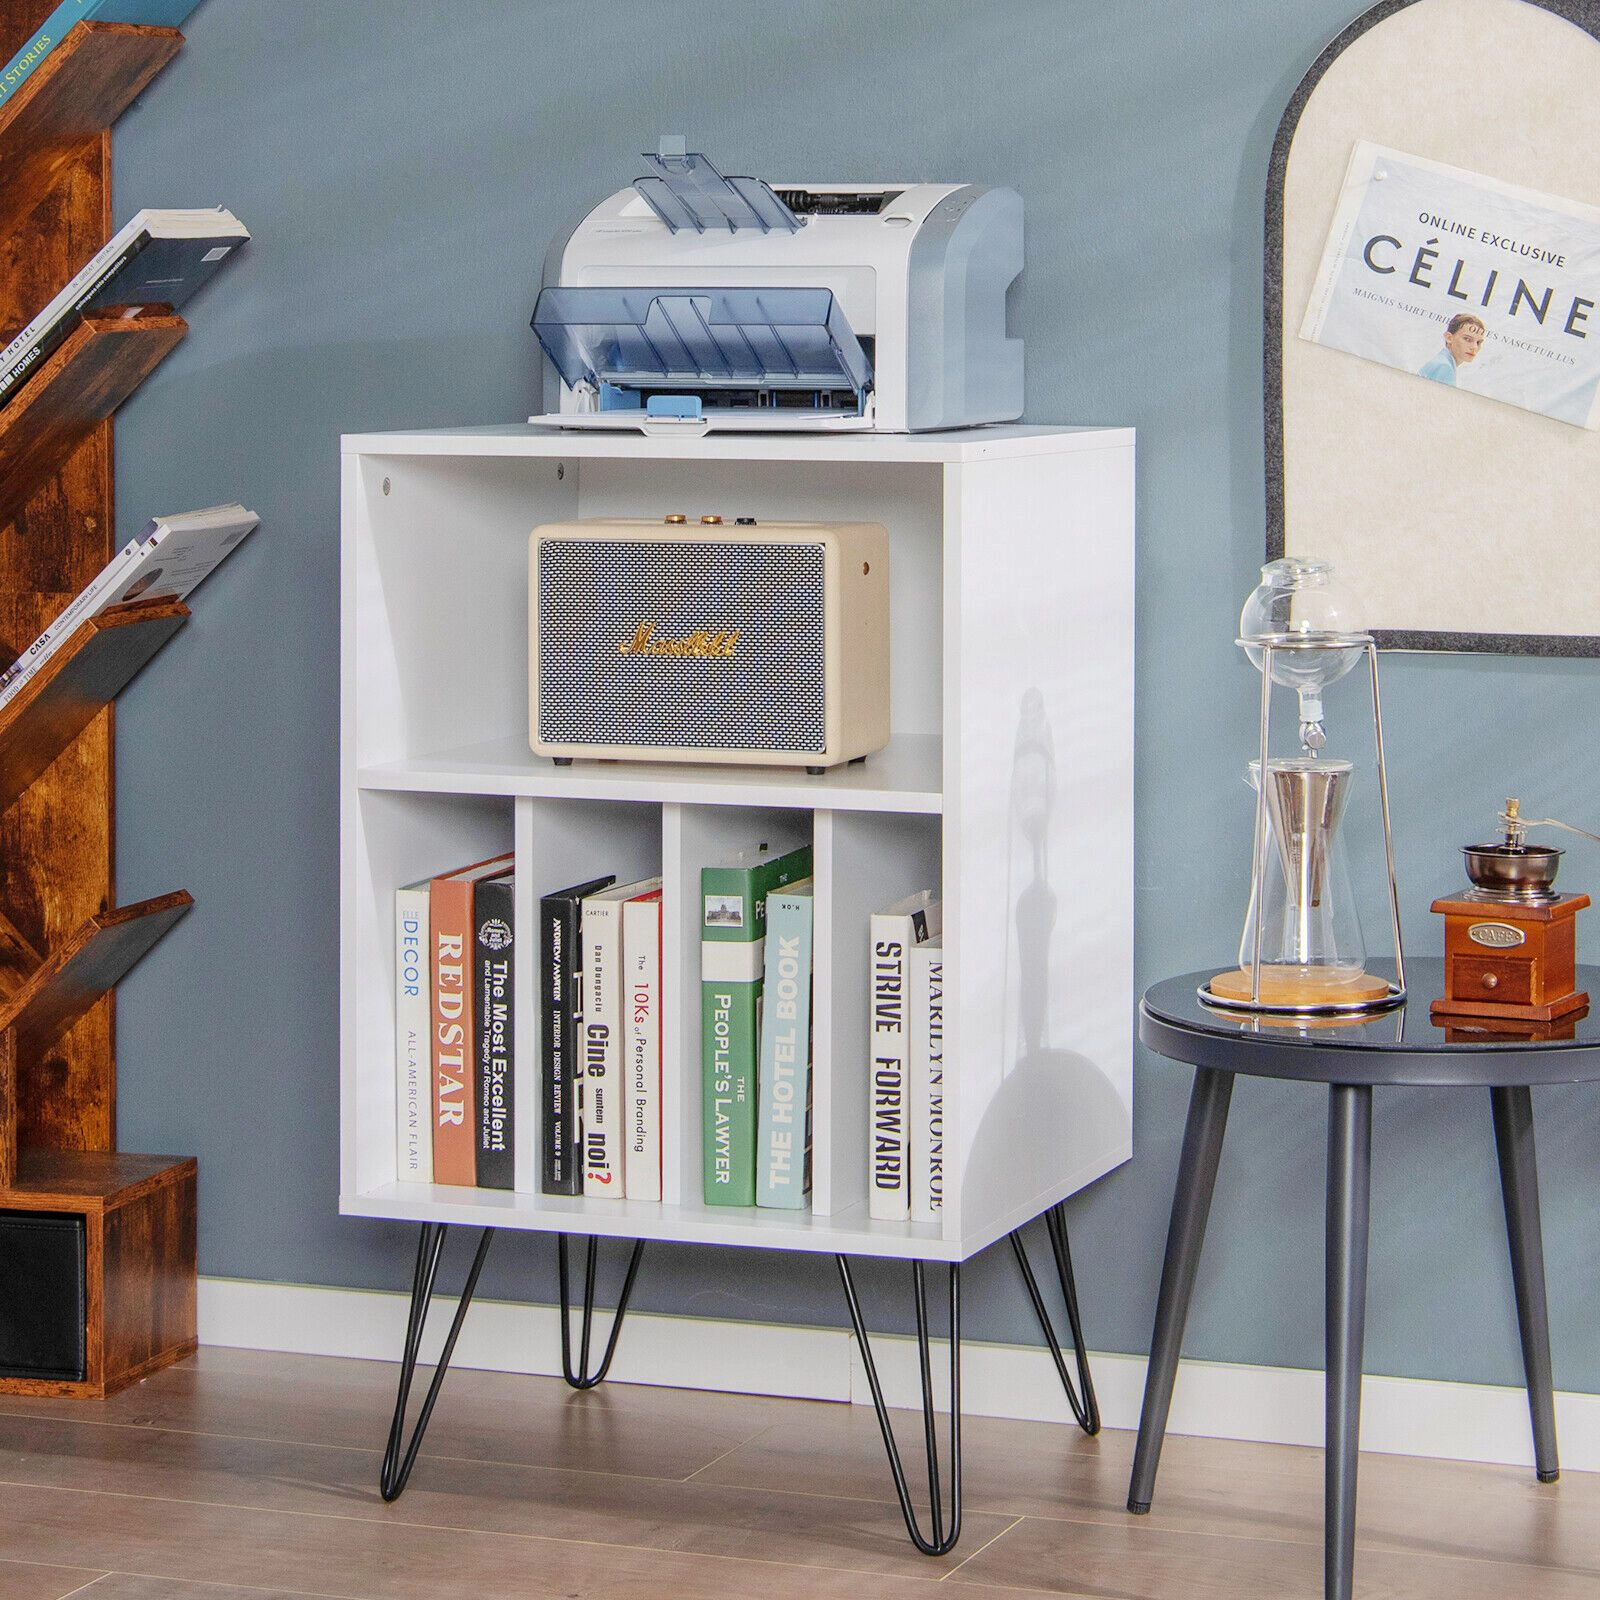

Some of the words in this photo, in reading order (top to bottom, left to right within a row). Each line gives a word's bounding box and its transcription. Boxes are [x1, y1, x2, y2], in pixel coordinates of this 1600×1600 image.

[5, 34, 51, 85] STORIES
[1418, 211, 1477, 240] ONLINE
[1481, 231, 1567, 269] EXCLUSIVE
[1363, 234, 1596, 340] CÉLINE
[8, 326, 36, 355] HOTEL
[13, 346, 42, 378] HOMES
[29, 633, 51, 656] CASA
[54, 594, 89, 631] CONTEMPORARY
[87, 584, 98, 596] LIFE
[403, 920, 419, 997] DECOR
[553, 918, 561, 963] ANDREW
[594, 945, 602, 963] Dan
[638, 955, 646, 970] The
[483, 978, 492, 1028] Lamentable
[492, 961, 508, 999] The
[553, 963, 561, 1001] MARTIN
[594, 966, 602, 1012] Dungaciu
[634, 983, 649, 1023] 10Ks
[776, 936, 800, 1021] BOOK
[875, 942, 902, 1033] STRIVE
[438, 931, 465, 1127] REDSTAR
[482, 1030, 491, 1065] Tragedy
[492, 1003, 508, 1054] Most
[553, 1010, 561, 1049] INTERIOR
[634, 1027, 642, 1036] of
[714, 994, 732, 1093] PEOPLE'S
[928, 961, 943, 1086] MARILYN
[483, 1065, 491, 1075] of
[553, 1051, 561, 1081] DESIGN
[586, 1024, 610, 1078] Cine
[635, 1037, 647, 1093] Personal
[772, 1027, 796, 1124] HOTEL
[408, 1031, 418, 1128] ALL-AMERICAN
[483, 1076, 491, 1107] Romeo
[491, 1058, 508, 1151] Excellent
[553, 1084, 561, 1114] REVIEW
[737, 1076, 746, 1102] THE
[483, 1108, 491, 1126] and
[595, 1088, 603, 1124] suntem
[634, 1098, 647, 1153] Branding
[875, 1057, 901, 1190] FORWARD
[408, 1134, 418, 1170] FLAIR
[482, 1126, 491, 1149] Juliet
[587, 1133, 612, 1184] noi?
[714, 1098, 732, 1184] LAWYER
[769, 1130, 793, 1189] THE
[929, 1093, 943, 1211] MONROE
